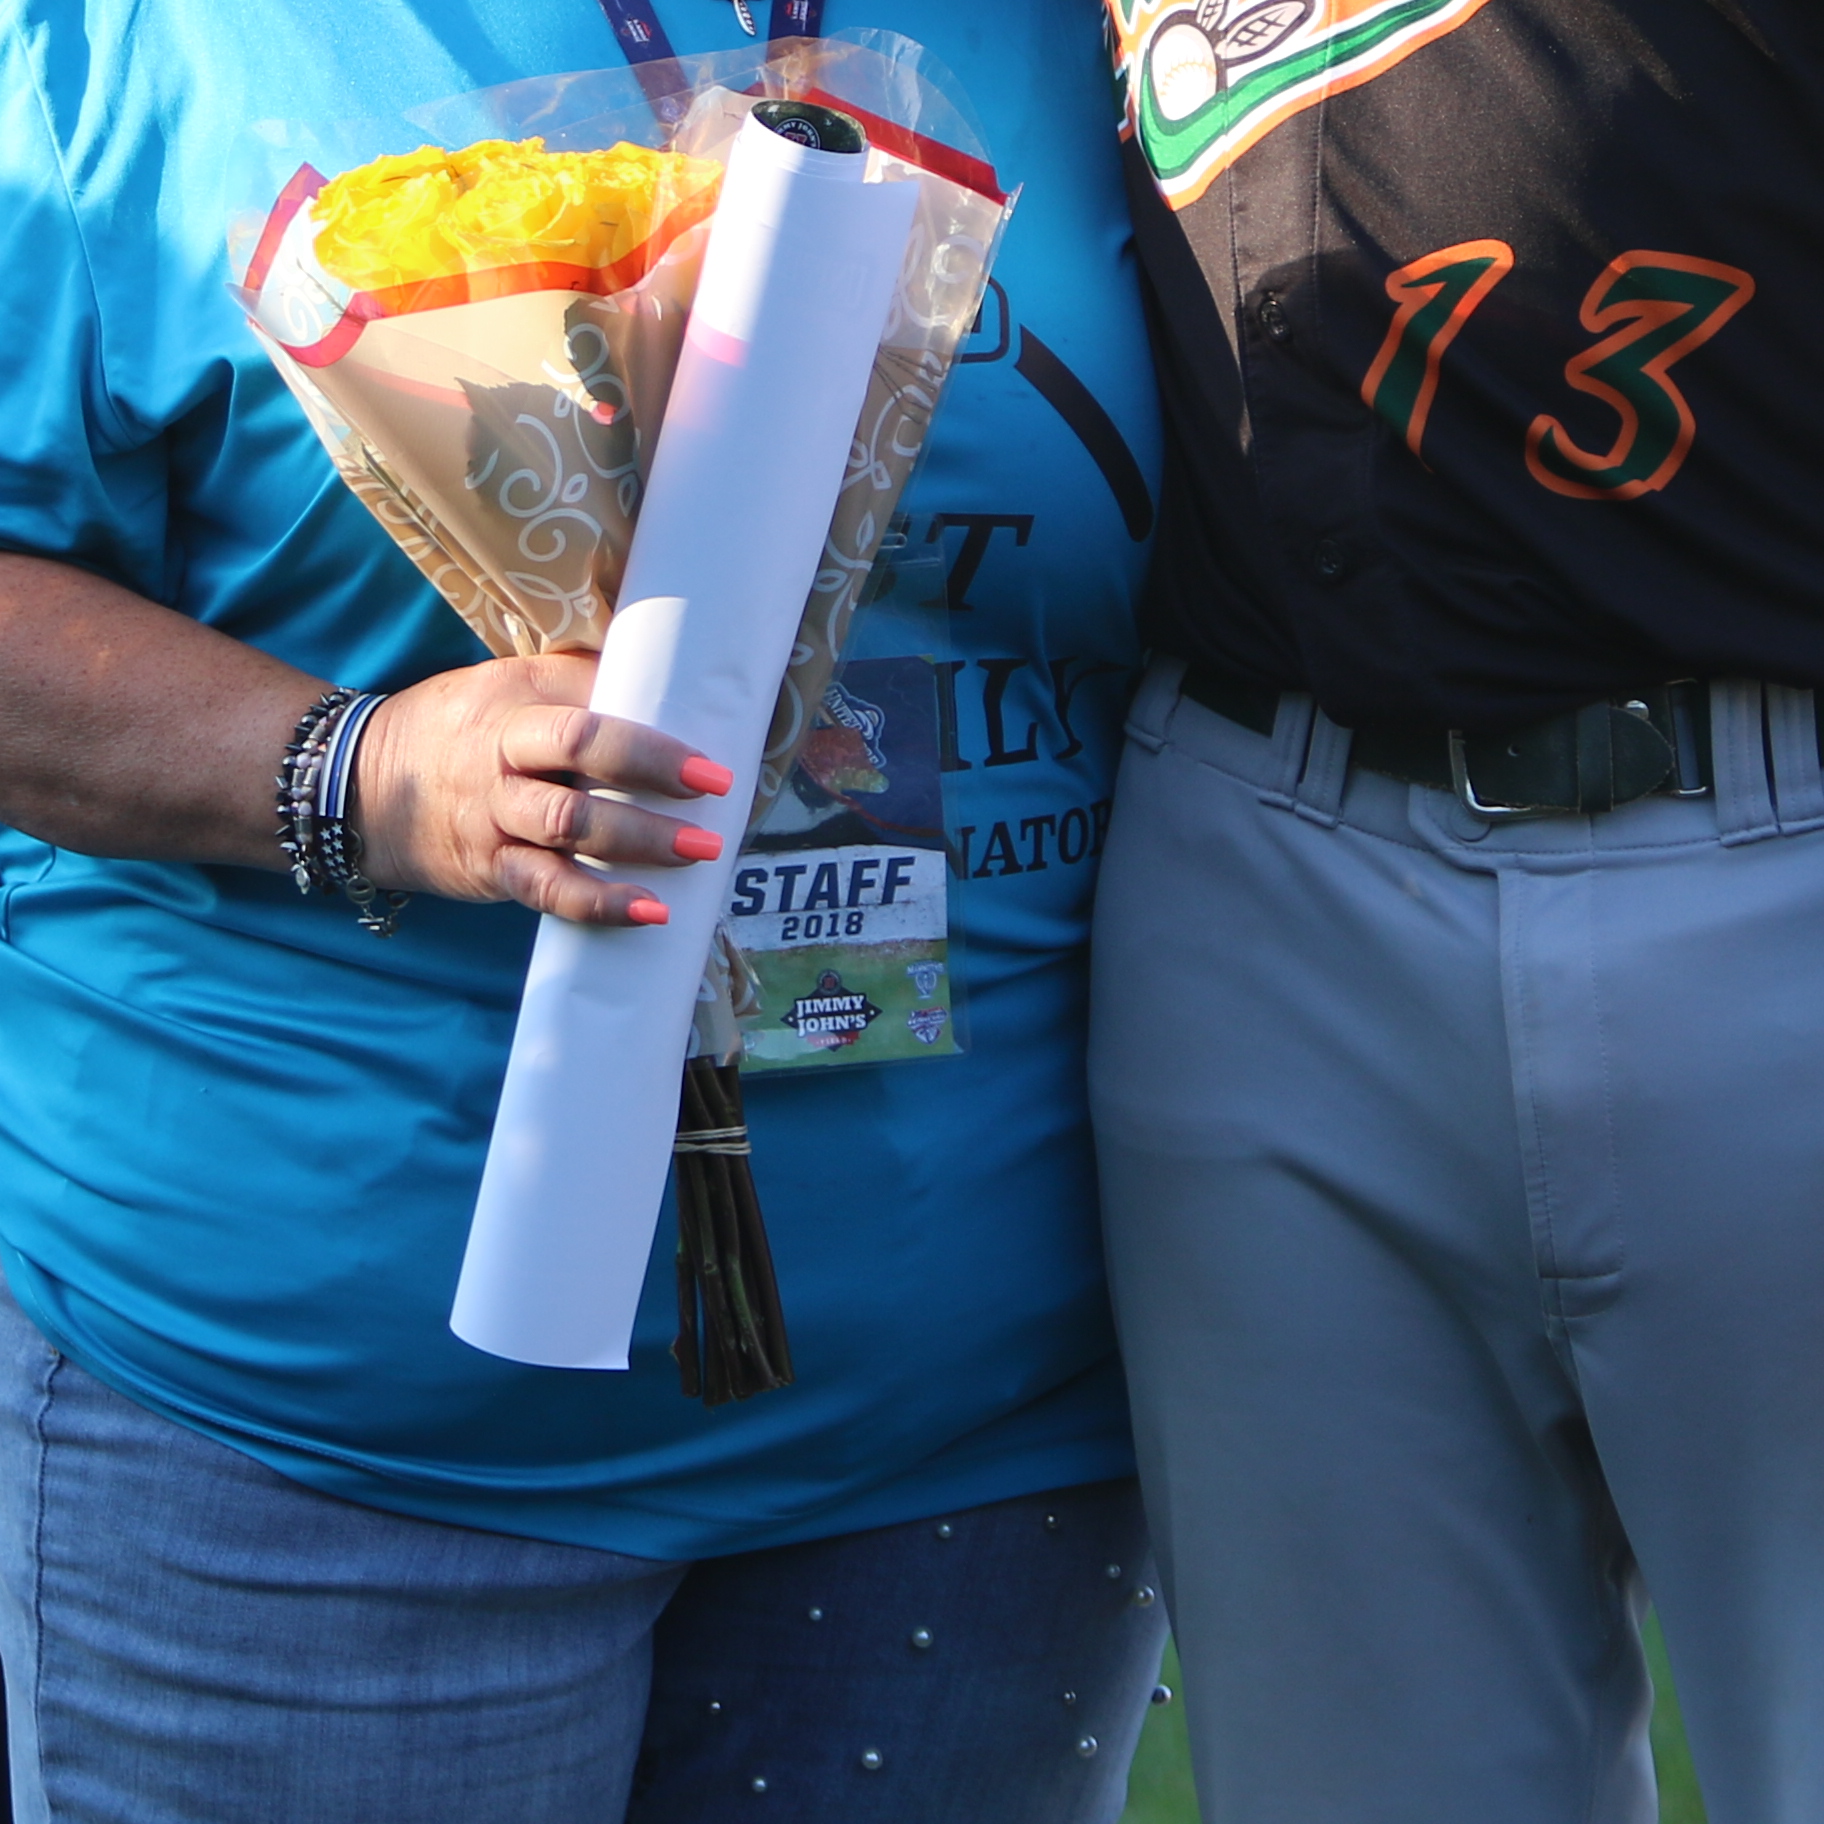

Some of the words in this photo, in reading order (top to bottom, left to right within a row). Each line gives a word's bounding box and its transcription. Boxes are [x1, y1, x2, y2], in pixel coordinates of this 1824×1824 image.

[1360, 238, 1757, 500] 13
[934, 654, 1138, 772] ILY
[731, 856, 915, 916] STAFF
[781, 911, 864, 941] 2018
[796, 994, 865, 1018] JIMMY
[798, 1013, 867, 1037] JOHN'S
